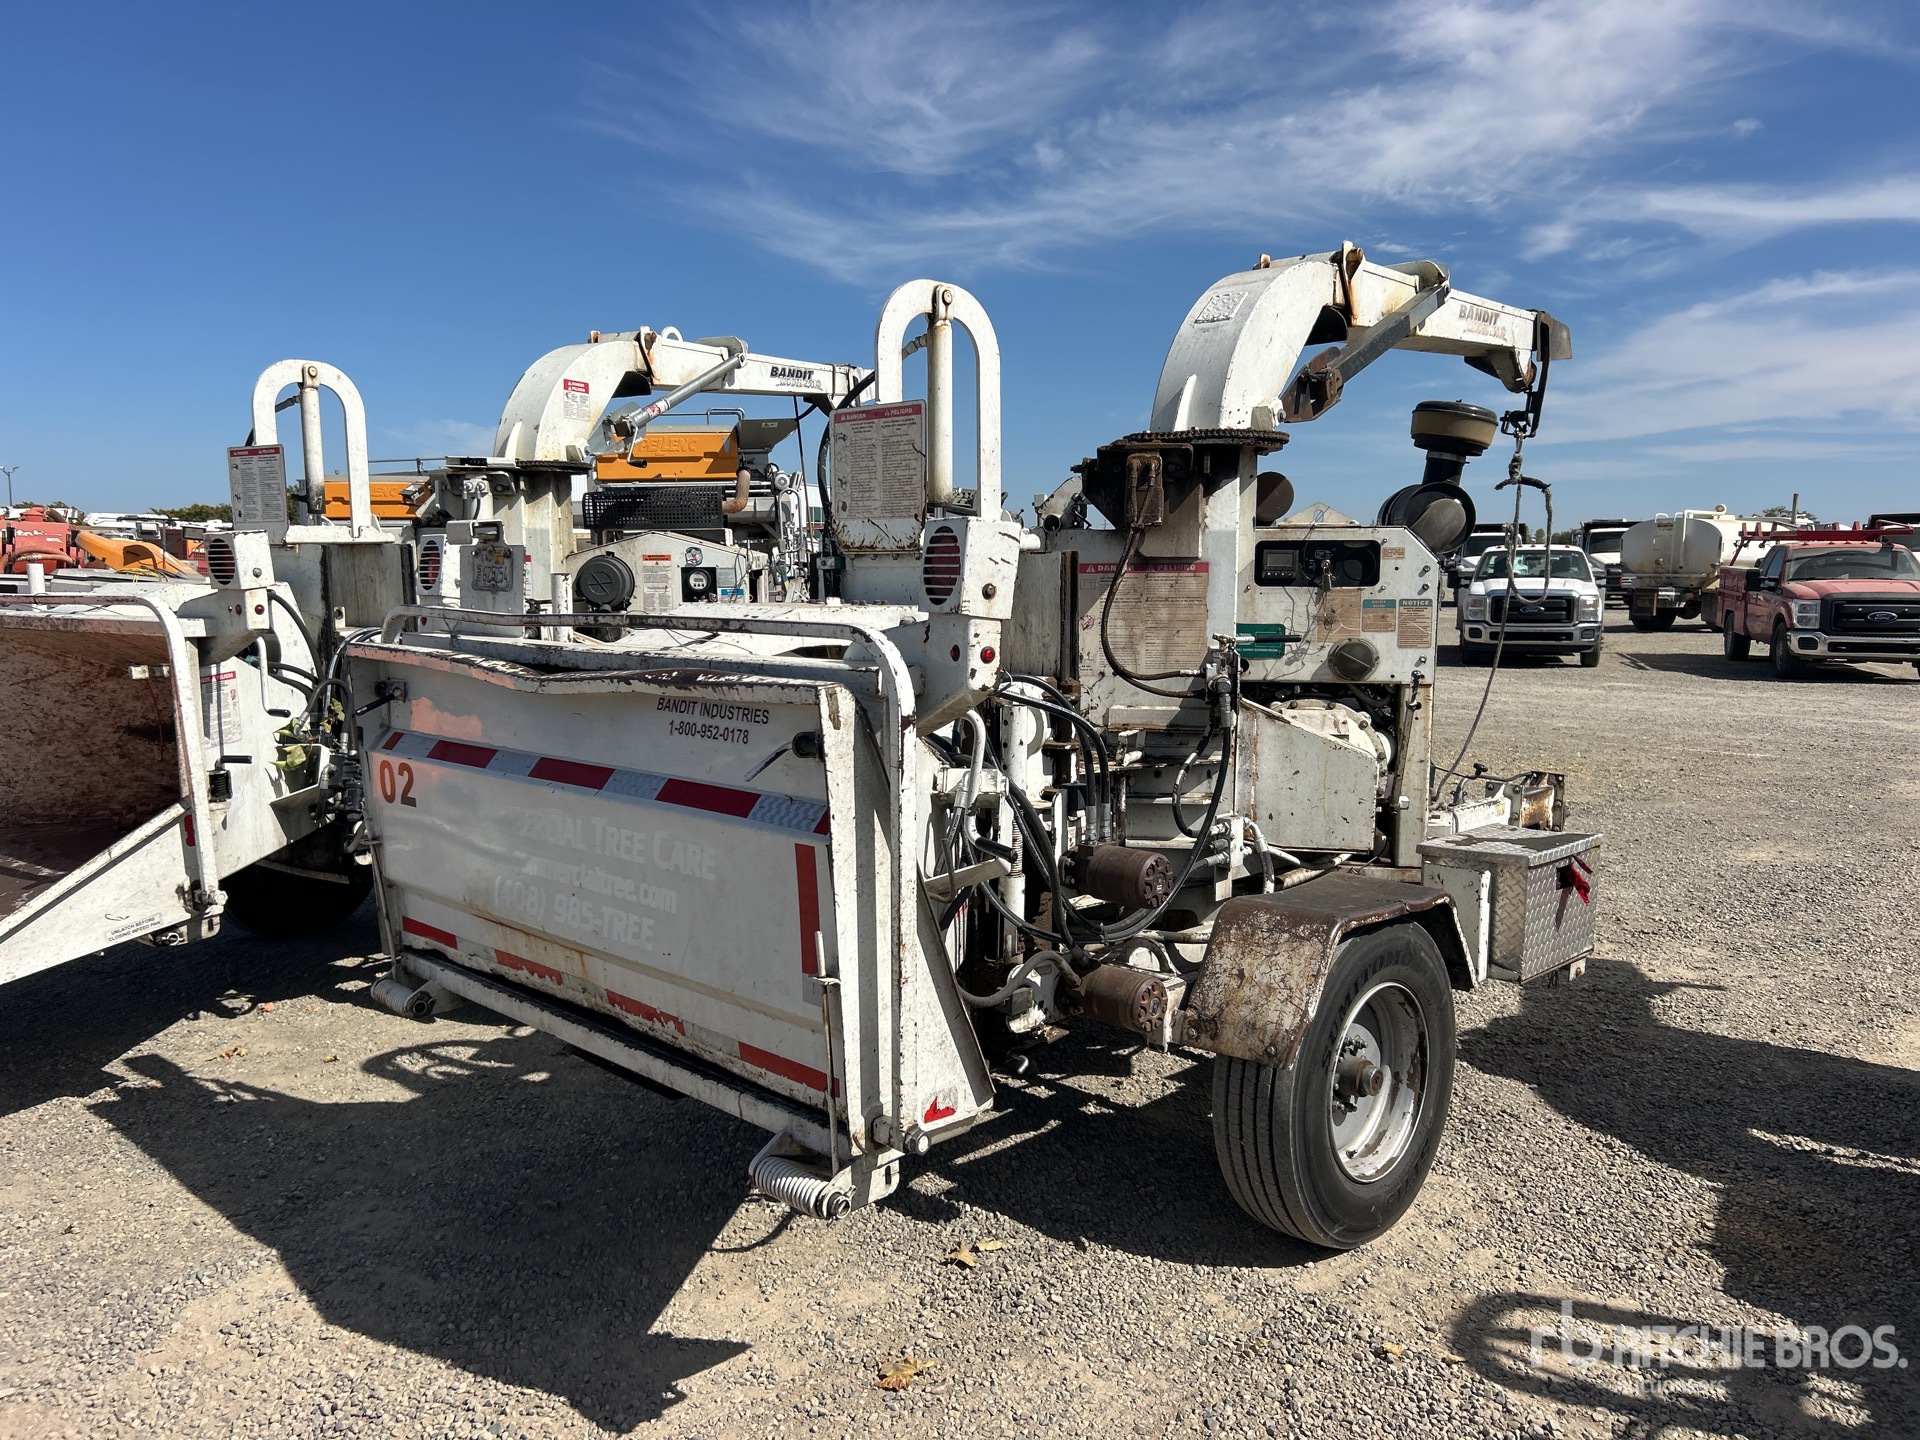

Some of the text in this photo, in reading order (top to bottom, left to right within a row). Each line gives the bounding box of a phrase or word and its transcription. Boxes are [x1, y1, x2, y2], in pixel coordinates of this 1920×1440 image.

[1459, 303, 1500, 326] BANDIT
[770, 366, 815, 380] BANDIT
[890, 407, 913, 416] PELIGRO
[1157, 563, 1197, 571] PELIGRO
[656, 697, 770, 725] BANDIT INDUSTRIES
[668, 720, 750, 745] 1-800-952-0178
[380, 760, 417, 808] 02
[592, 816, 646, 865] TREE
[653, 830, 717, 881] CARE
[108, 930, 132, 942] CLOSING
[132, 924, 150, 934] INFEED
[111, 917, 155, 936] UNLATCH BEFORE
